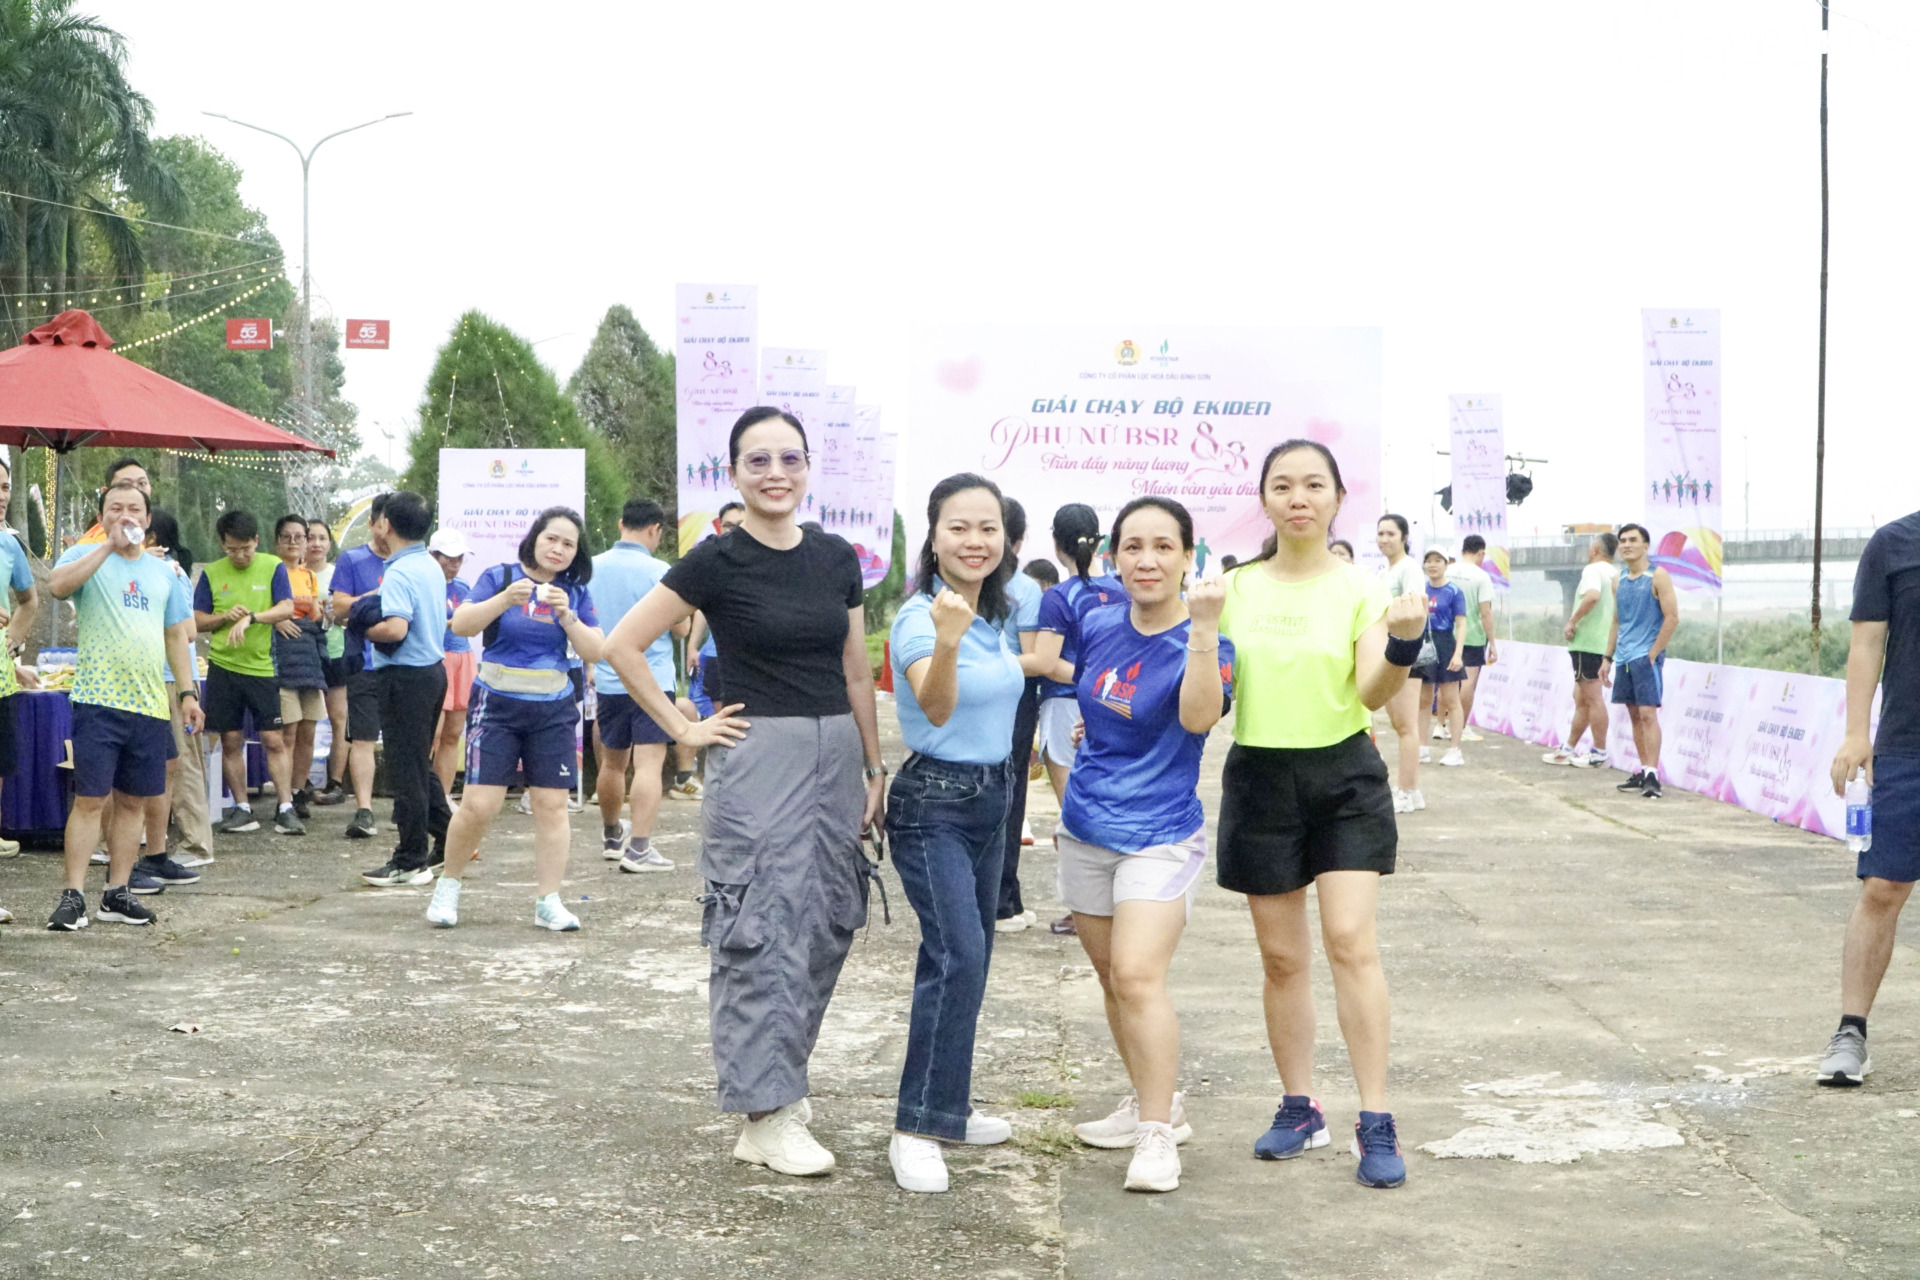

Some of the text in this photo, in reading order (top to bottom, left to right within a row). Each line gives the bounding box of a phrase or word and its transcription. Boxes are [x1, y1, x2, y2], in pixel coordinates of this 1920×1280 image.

[239, 326, 258, 339] 5G
[358, 326, 377, 339] 5G
[1031, 395, 1272, 418] GIẢI CHẠY BỘ EKIDEN
[982, 416, 1072, 471] PHỤ
[1080, 424, 1119, 446] NỮ
[1125, 426, 1179, 446] BSR
[1041, 452, 1078, 472] Tràn
[1112, 457, 1148, 475] năng
[1151, 456, 1190, 475] lượng
[1131, 477, 1178, 496] Muôn
[1180, 481, 1207, 496] vàn
[1209, 481, 1232, 499] yêu
[1207, 505, 1227, 513] 2026
[123, 592, 149, 612] BSR
[1111, 680, 1137, 700] BSR
